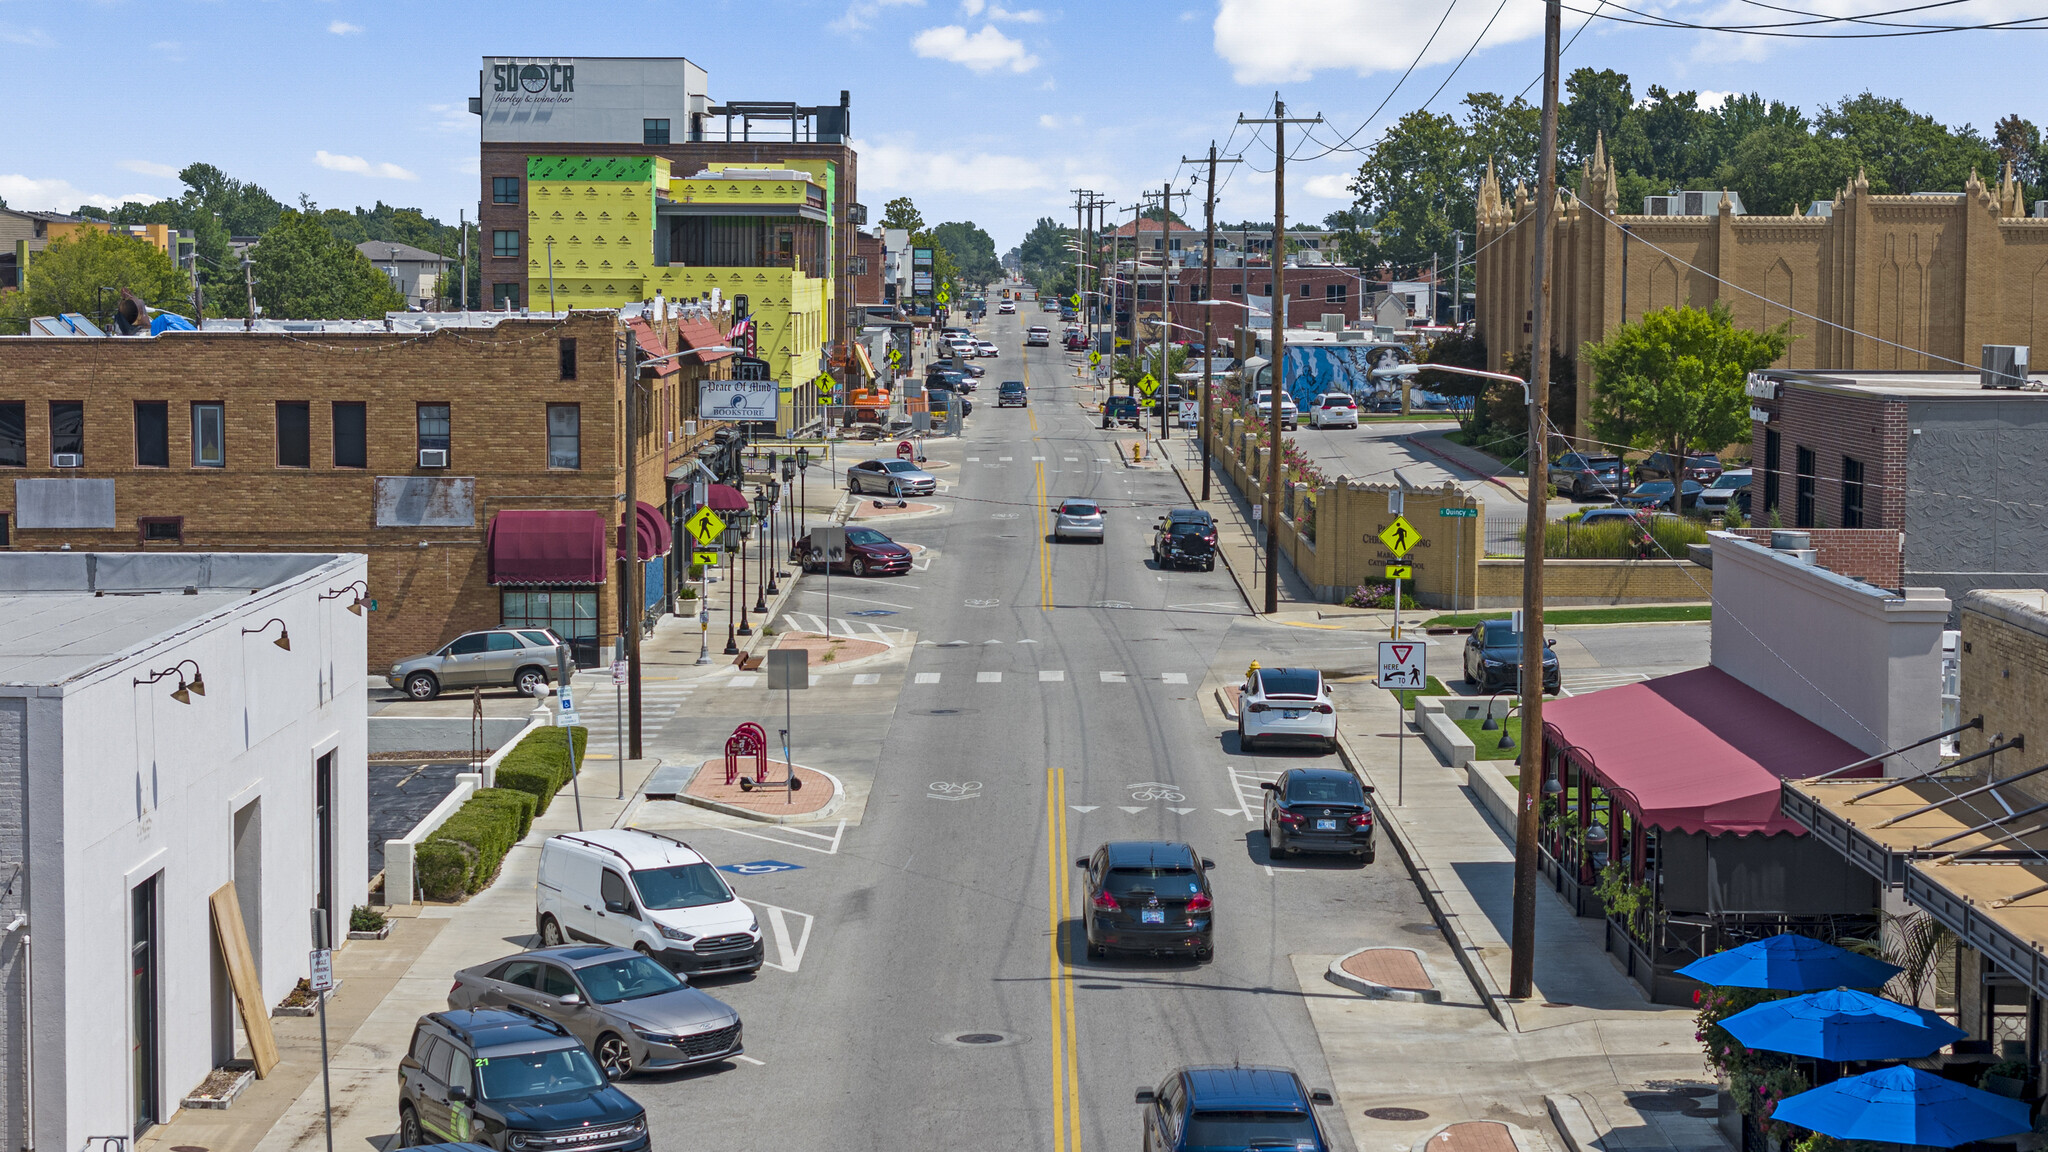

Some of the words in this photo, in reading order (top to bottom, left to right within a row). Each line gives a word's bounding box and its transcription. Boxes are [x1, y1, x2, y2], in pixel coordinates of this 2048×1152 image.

[495, 93, 522, 106] barley
[525, 95, 533, 103] &
[557, 93, 573, 103] bar
[707, 382, 732, 393] Peace
[735, 382, 747, 392] Of
[748, 382, 772, 393] Mind
[1445, 508, 1467, 517] Quincy
[475, 1058, 489, 1067] 21
[556, 1131, 619, 1143] BRONCO
